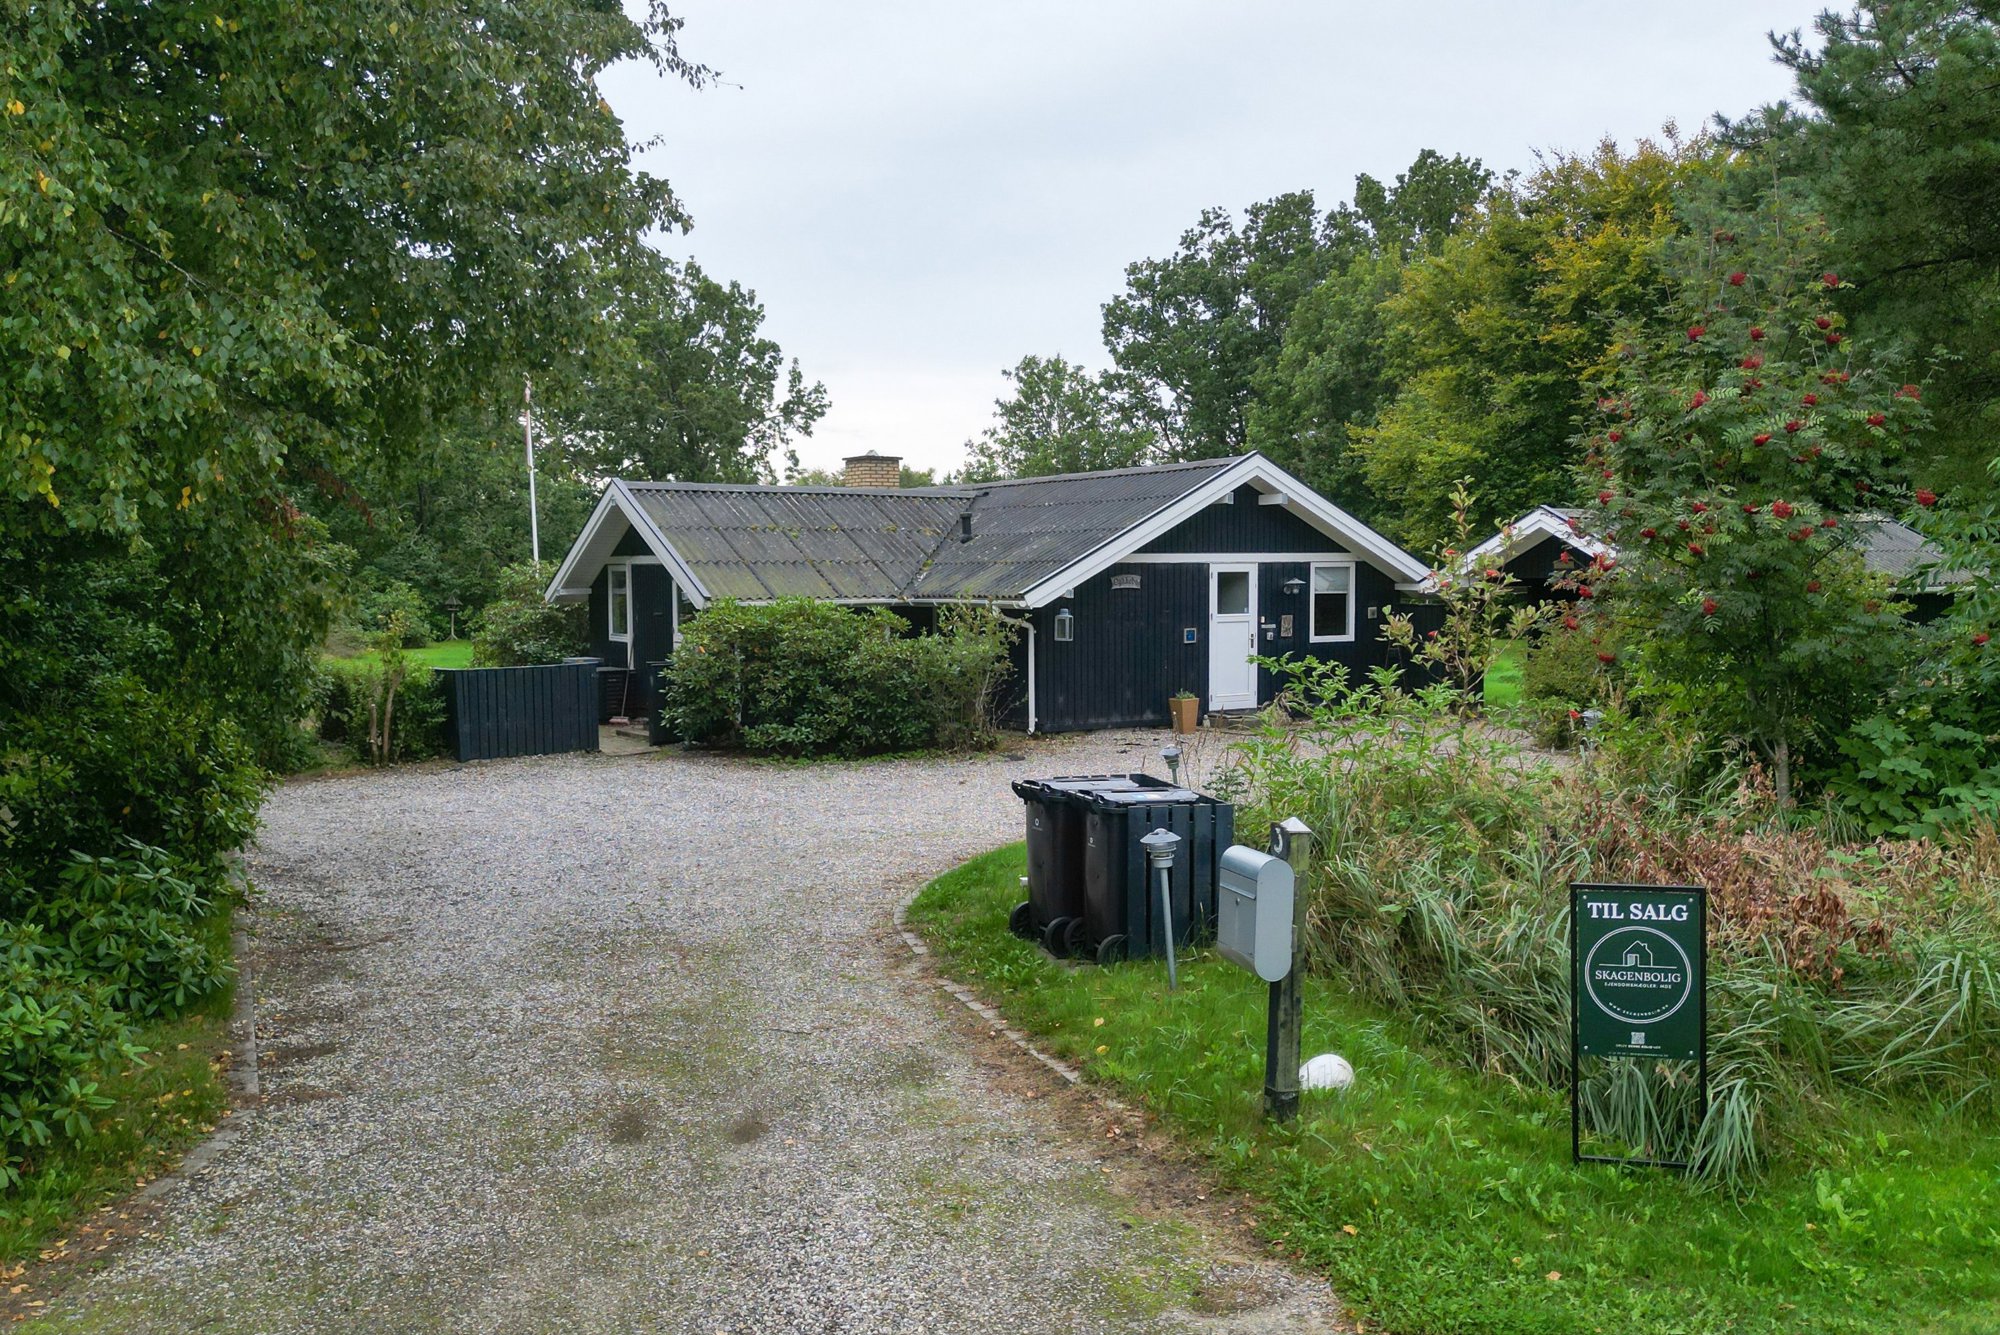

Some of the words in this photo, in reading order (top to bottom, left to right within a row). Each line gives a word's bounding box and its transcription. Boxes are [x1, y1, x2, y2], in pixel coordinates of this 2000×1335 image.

[1587, 902, 1625, 919] TIL
[1629, 903, 1688, 921] SALG
[1595, 970, 1681, 983] SKAGENBOLIG
